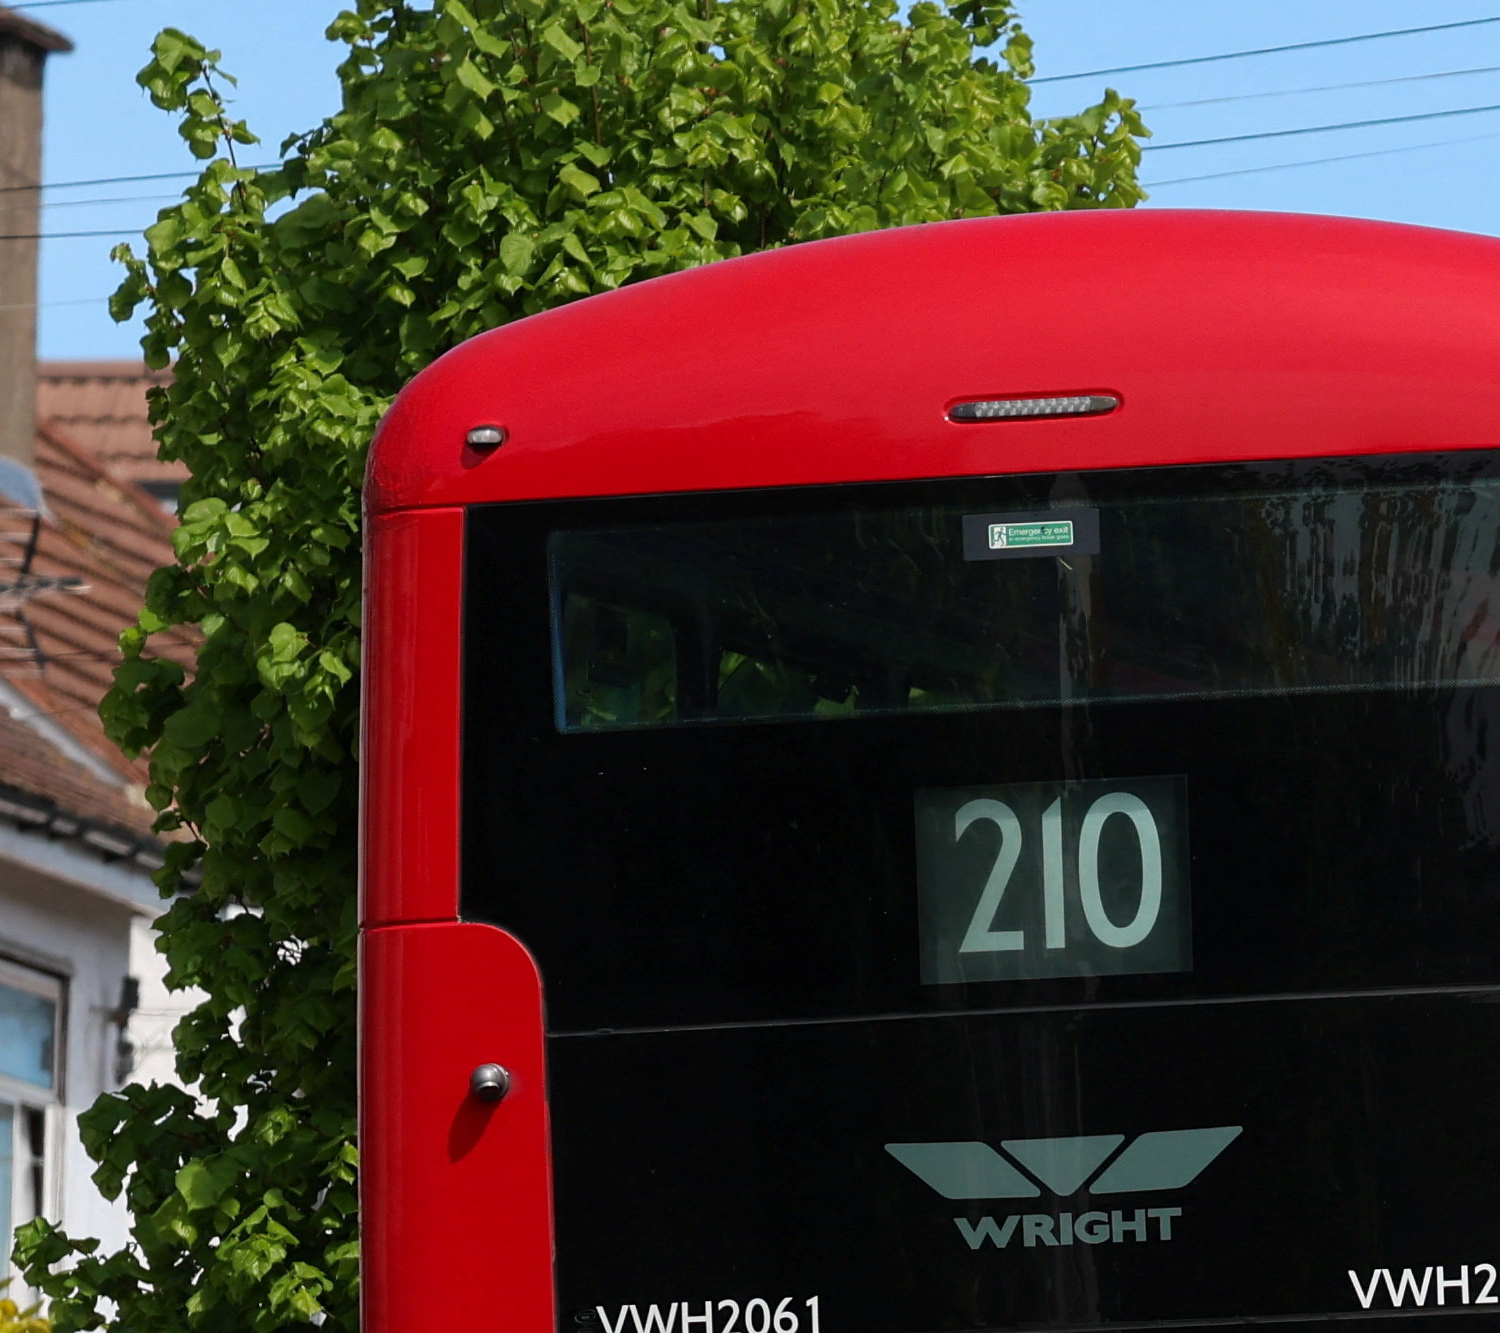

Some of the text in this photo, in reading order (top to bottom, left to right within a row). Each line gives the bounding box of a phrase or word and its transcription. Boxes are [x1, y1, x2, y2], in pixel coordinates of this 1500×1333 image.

[1053, 525, 1069, 534] exit
[954, 791, 1163, 953] 210
[953, 1207, 1183, 1250] WRIGHT
